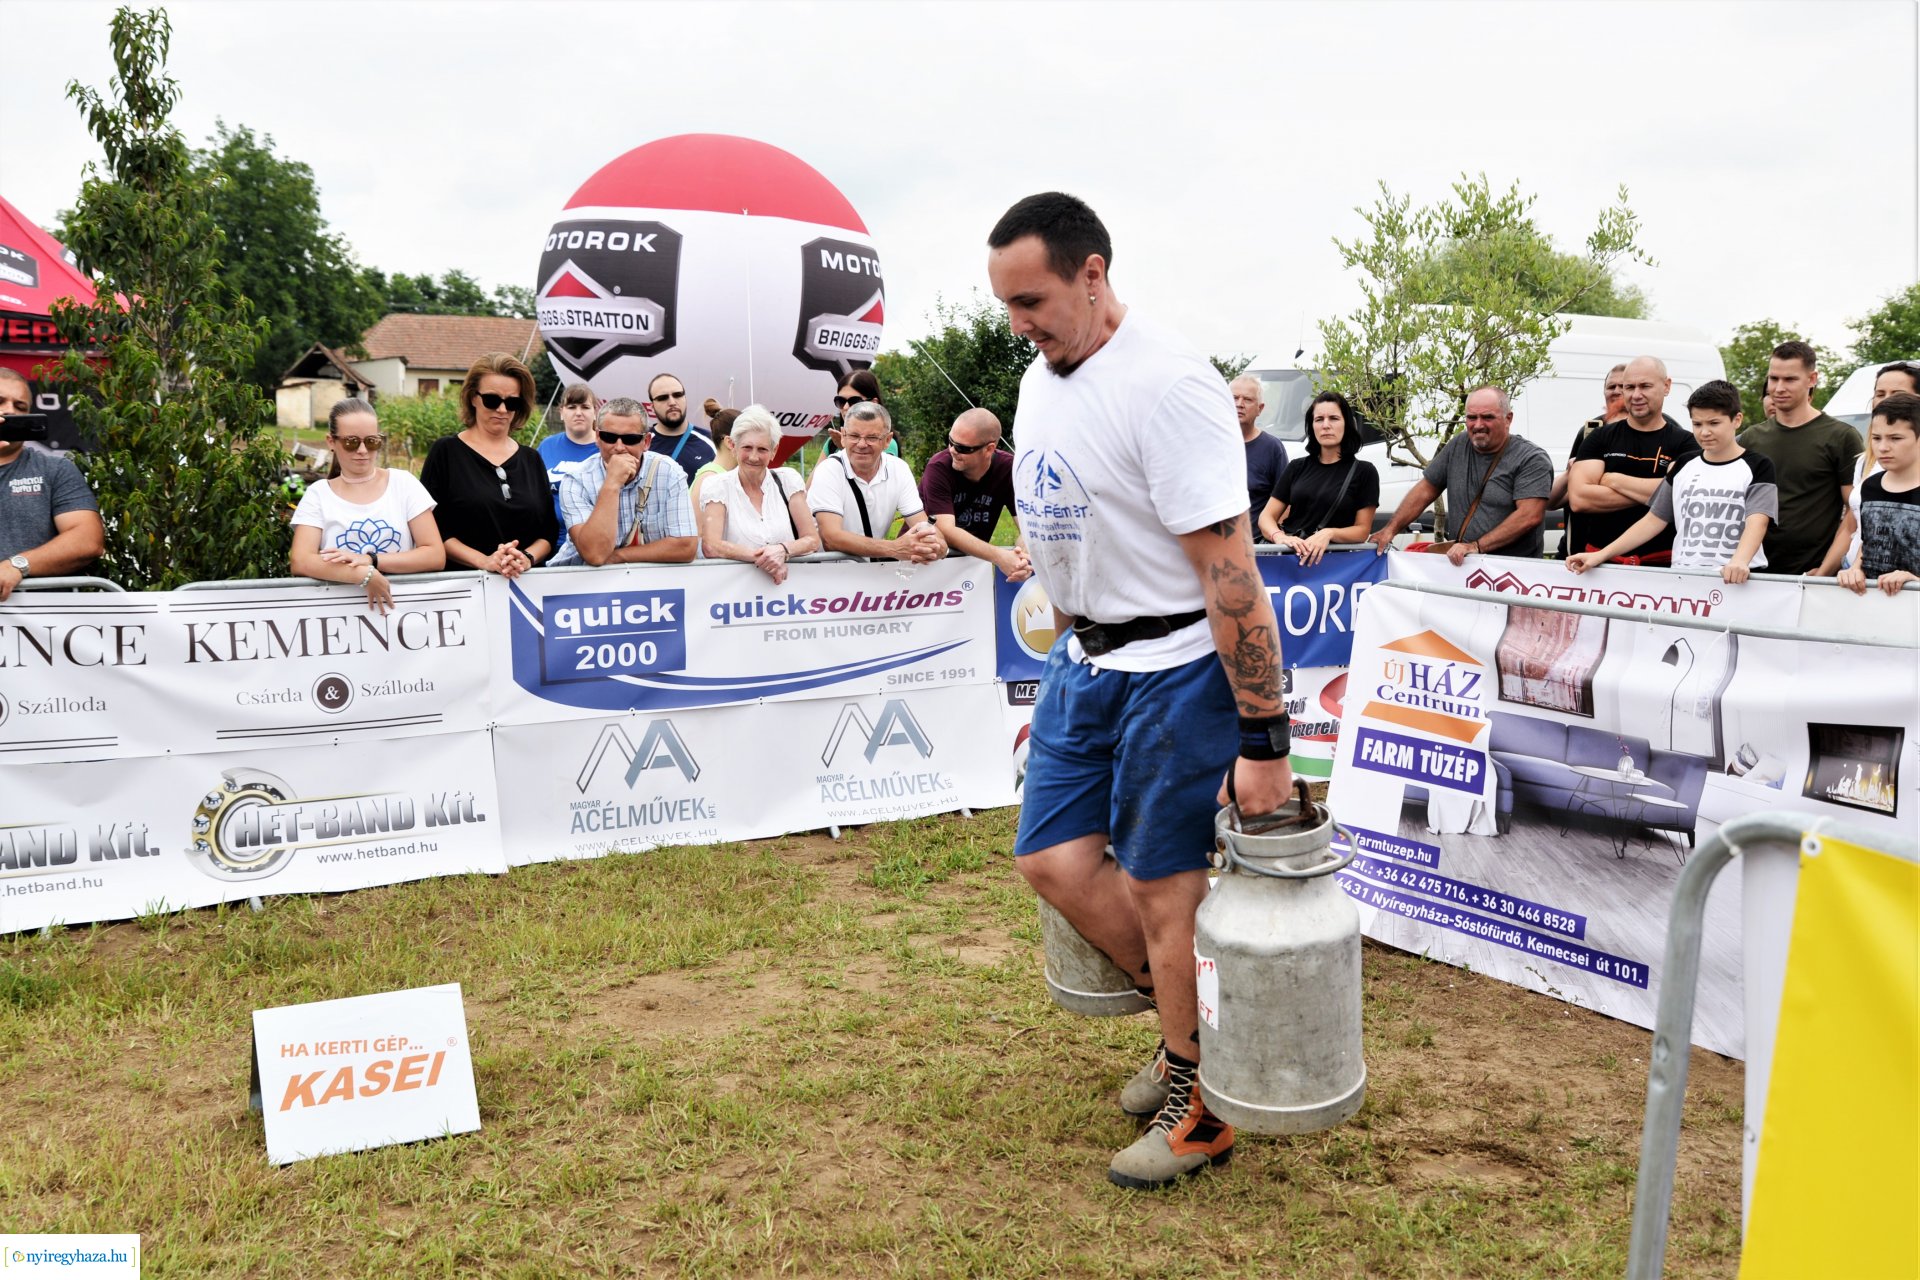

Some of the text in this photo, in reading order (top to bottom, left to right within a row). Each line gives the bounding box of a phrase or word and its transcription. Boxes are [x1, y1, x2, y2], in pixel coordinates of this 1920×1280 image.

[544, 231, 658, 252] OTOROK
[821, 249, 882, 278] MOTO
[1681, 498, 1746, 521] down
[1683, 517, 1746, 541] load
[555, 595, 676, 634] quick
[710, 587, 964, 624] quicksolutions
[0, 624, 147, 668] NCE
[183, 608, 466, 664] KEMENCE
[763, 621, 914, 643] FROM HUNGARY
[575, 640, 658, 671] 2000
[236, 687, 303, 707] Csárda
[361, 677, 435, 698] Szálloda
[886, 667, 976, 686] SINCE 1991
[1015, 683, 1038, 700] ME
[17, 696, 107, 716] Szálloda
[1376, 684, 1480, 718] Centrum
[1361, 737, 1479, 783] FARM TÜZÉP
[816, 774, 844, 783] MAGYAR
[820, 771, 946, 803] ACÉLMŰVEK
[234, 791, 486, 849] HET-BAND Kft.
[570, 800, 601, 811] MAGYAR
[570, 796, 708, 834] ACÉLMŰVEK
[89, 822, 160, 861] Kft.
[317, 840, 439, 865] www.hetband.hu
[1355, 832, 1432, 864] farmtuzep.hu
[0, 876, 104, 899] .hetband.hu
[1352, 859, 1374, 875] el.:
[1376, 866, 1398, 882] +36
[1400, 872, 1417, 887] 42
[1418, 877, 1442, 894] 475
[1444, 883, 1469, 903] 716,
[1482, 893, 1497, 910] 36
[1500, 899, 1515, 915] 30
[1517, 904, 1541, 923] 466
[1543, 911, 1576, 934] 8528
[1337, 877, 1369, 899] 4431
[1527, 935, 1590, 967] Kemecsei
[1596, 957, 1610, 973] út
[1613, 962, 1643, 984] 101.
[281, 1035, 424, 1058] HA KERTI GÉP...
[279, 1050, 446, 1112] KASEI
